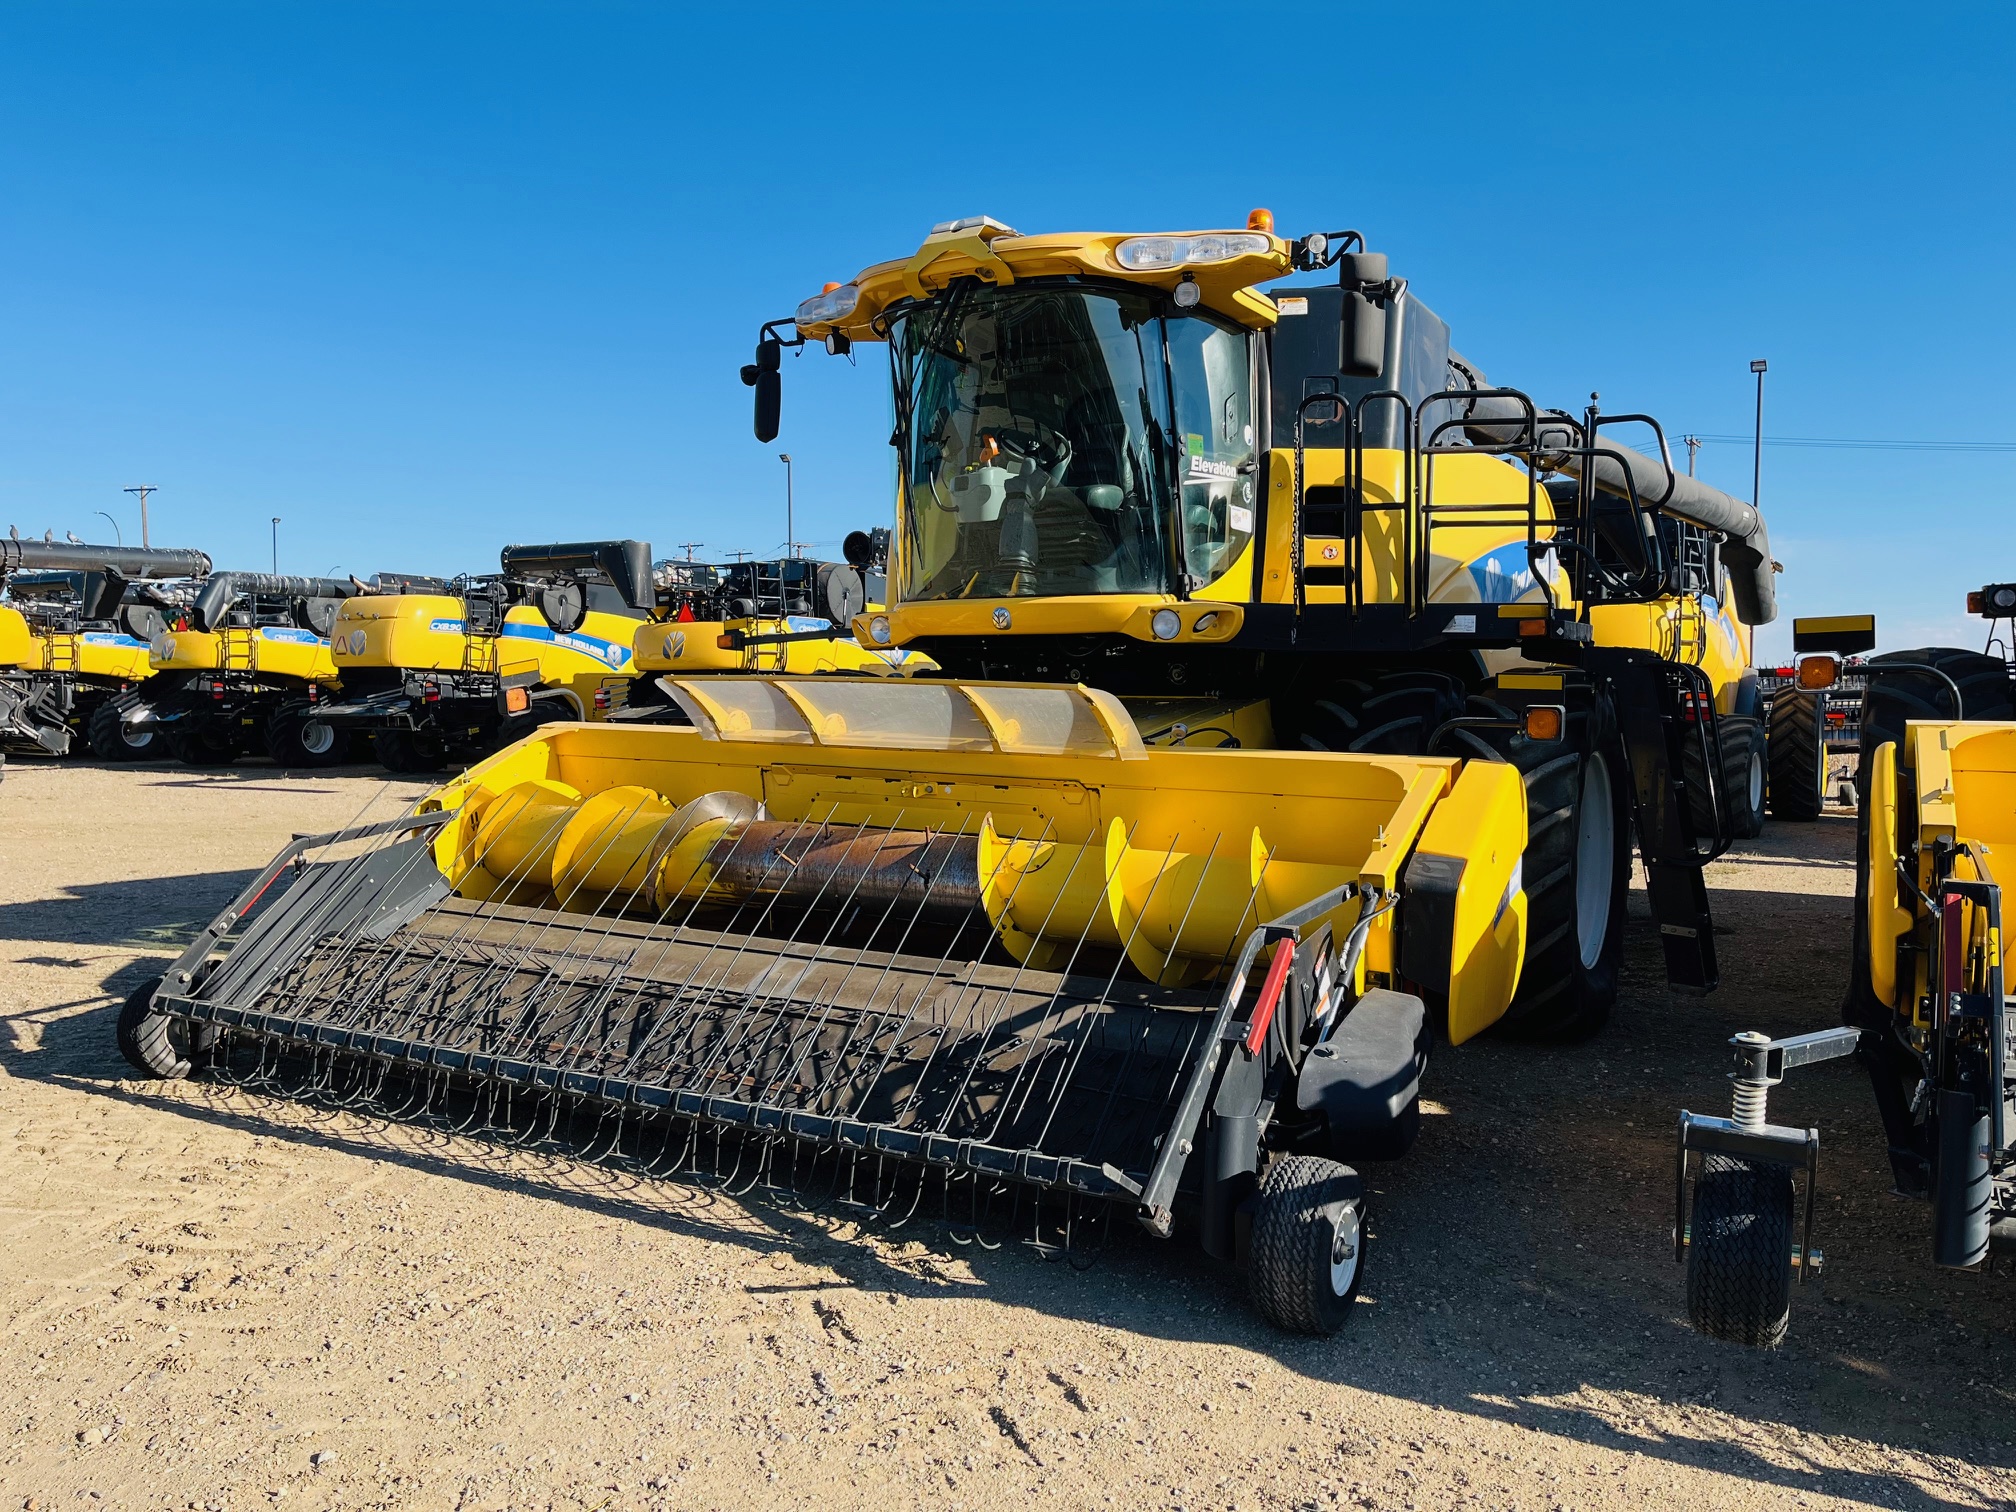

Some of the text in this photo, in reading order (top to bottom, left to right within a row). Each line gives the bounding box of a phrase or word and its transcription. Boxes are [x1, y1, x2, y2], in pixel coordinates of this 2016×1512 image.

[1190, 455, 1237, 478] Elevation
[554, 634, 605, 657] NEW HOLLAND
